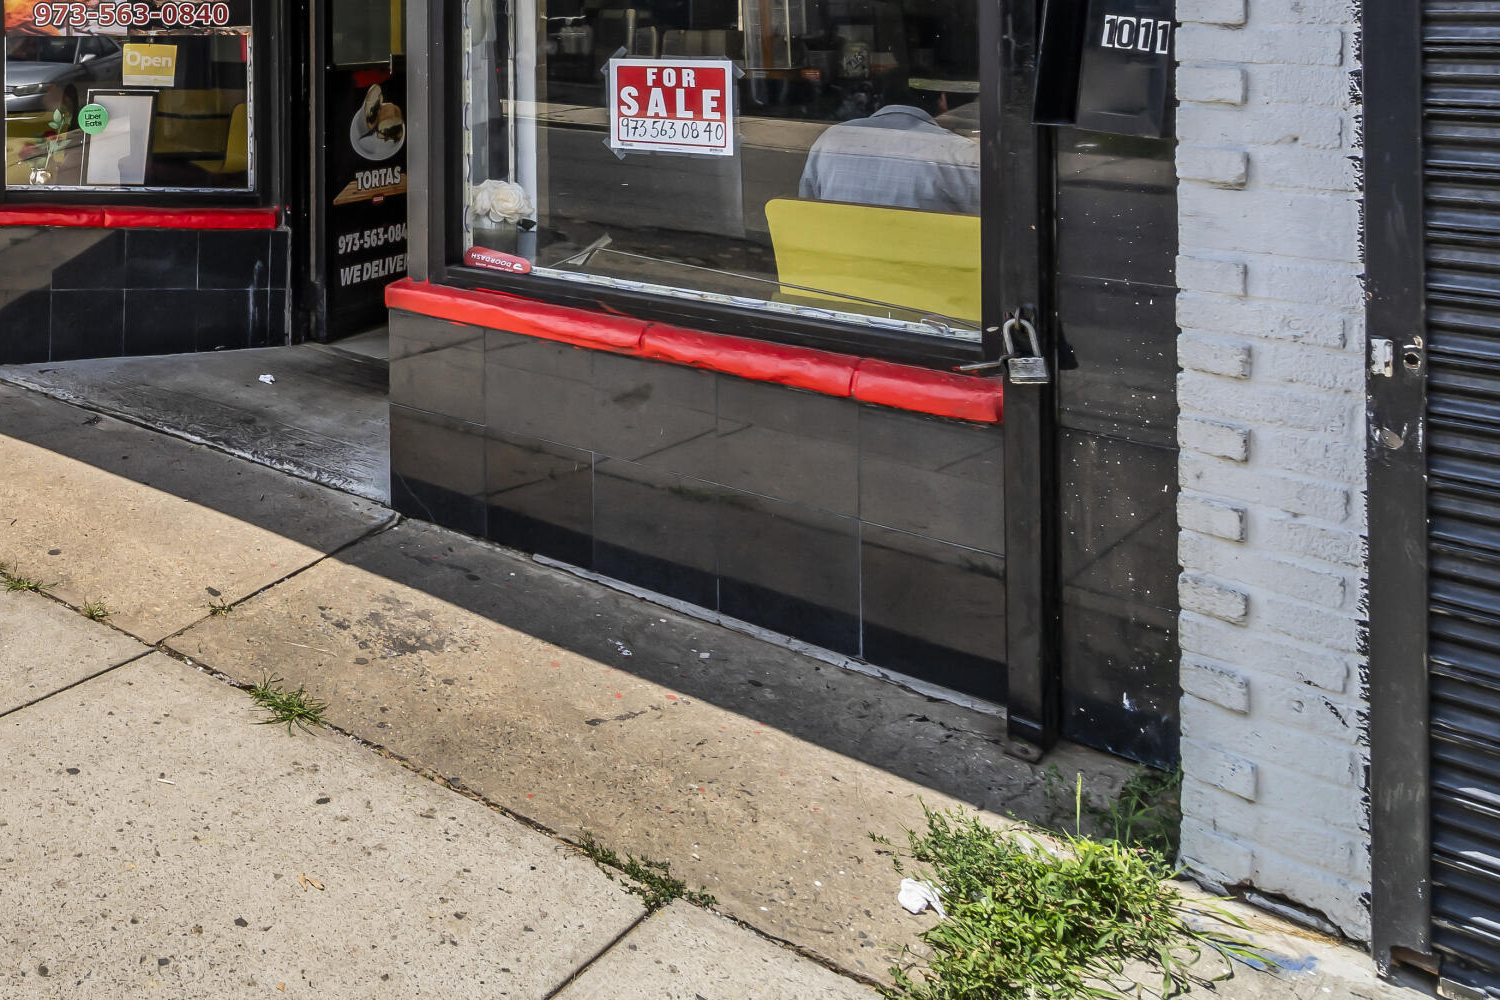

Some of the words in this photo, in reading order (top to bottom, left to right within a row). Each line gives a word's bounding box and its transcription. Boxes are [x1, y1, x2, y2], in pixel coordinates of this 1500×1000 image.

[34, 2, 229, 26] 973-563-0840
[1102, 15, 1171, 54] 1011
[126, 51, 172, 70] Open
[646, 68, 696, 87] FOR
[620, 86, 721, 119] SALE
[621, 118, 647, 137] 973
[650, 120, 676, 138] 563
[355, 166, 401, 191] TORTAS
[470, 252, 512, 267] DOORDASH
[341, 264, 362, 287] WE
